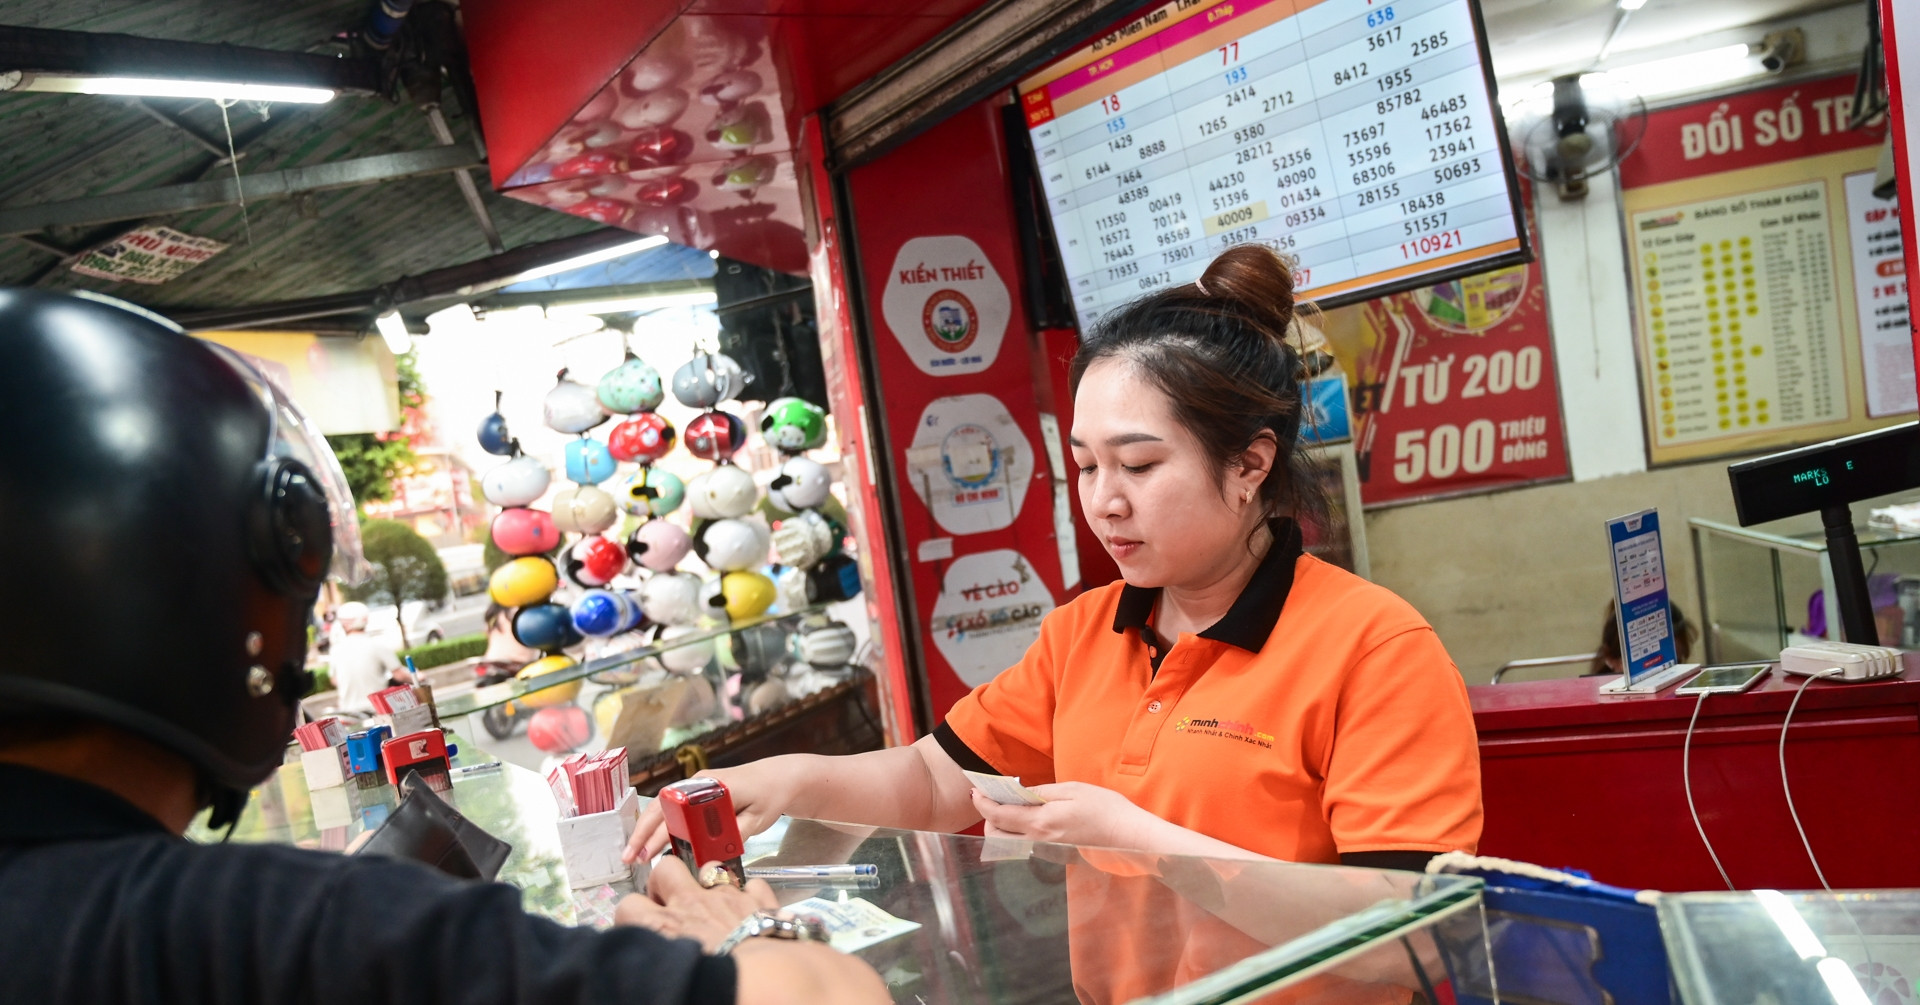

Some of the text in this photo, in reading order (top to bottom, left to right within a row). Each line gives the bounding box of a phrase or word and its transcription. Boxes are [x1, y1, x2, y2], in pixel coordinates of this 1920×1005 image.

[1143, 8, 1168, 27] Nam
[1366, 6, 1395, 28] 638
[1366, 26, 1402, 52] 3617
[1219, 41, 1239, 66] 77
[1334, 30, 1449, 86] 8412 2585
[1225, 66, 1248, 86] 193
[1377, 68, 1413, 92] 1955
[1101, 94, 1121, 115] 18
[1226, 85, 1256, 107] 2414
[1376, 88, 1423, 115] 85782
[1106, 116, 1126, 135] 153
[1199, 90, 1295, 137] 1265 2712
[1343, 94, 1468, 148] 73697 46483
[1754, 90, 1804, 147] SỐ
[1108, 134, 1133, 153] 1429
[1234, 123, 1265, 145] 9380
[1348, 115, 1473, 167] 35596 17362
[1085, 162, 1111, 181] 6144
[1138, 140, 1167, 160] 8888
[1235, 141, 1274, 165] 28212
[1352, 136, 1476, 186] 68306 23941
[1116, 168, 1143, 188] 7464
[1208, 147, 1312, 193] 44230 52356
[1357, 157, 1482, 207] 28155 50693
[1118, 185, 1150, 206] 48389
[1212, 166, 1316, 211] 51396 49090
[1095, 192, 1182, 232] 11350 00419
[1217, 185, 1321, 228] 40009 01434
[1400, 191, 1446, 216] 18438
[1100, 209, 1188, 249] 16572 70124
[1221, 206, 1326, 246] 93679 09334
[1404, 212, 1448, 236] 51557
[1103, 227, 1191, 264] 76443 96569
[1400, 229, 1463, 260] 110921
[899, 258, 985, 285] KIẾN THIẾT
[1108, 245, 1196, 281] 71933 75901
[1138, 271, 1172, 290] 08472
[1399, 345, 1542, 408] TỪ 200
[1393, 418, 1496, 484] 500
[1500, 415, 1547, 441] TRIỆU
[1502, 438, 1548, 463] ĐỒNG
[1845, 460, 1854, 470] E
[985, 579, 1020, 598] CÀO
